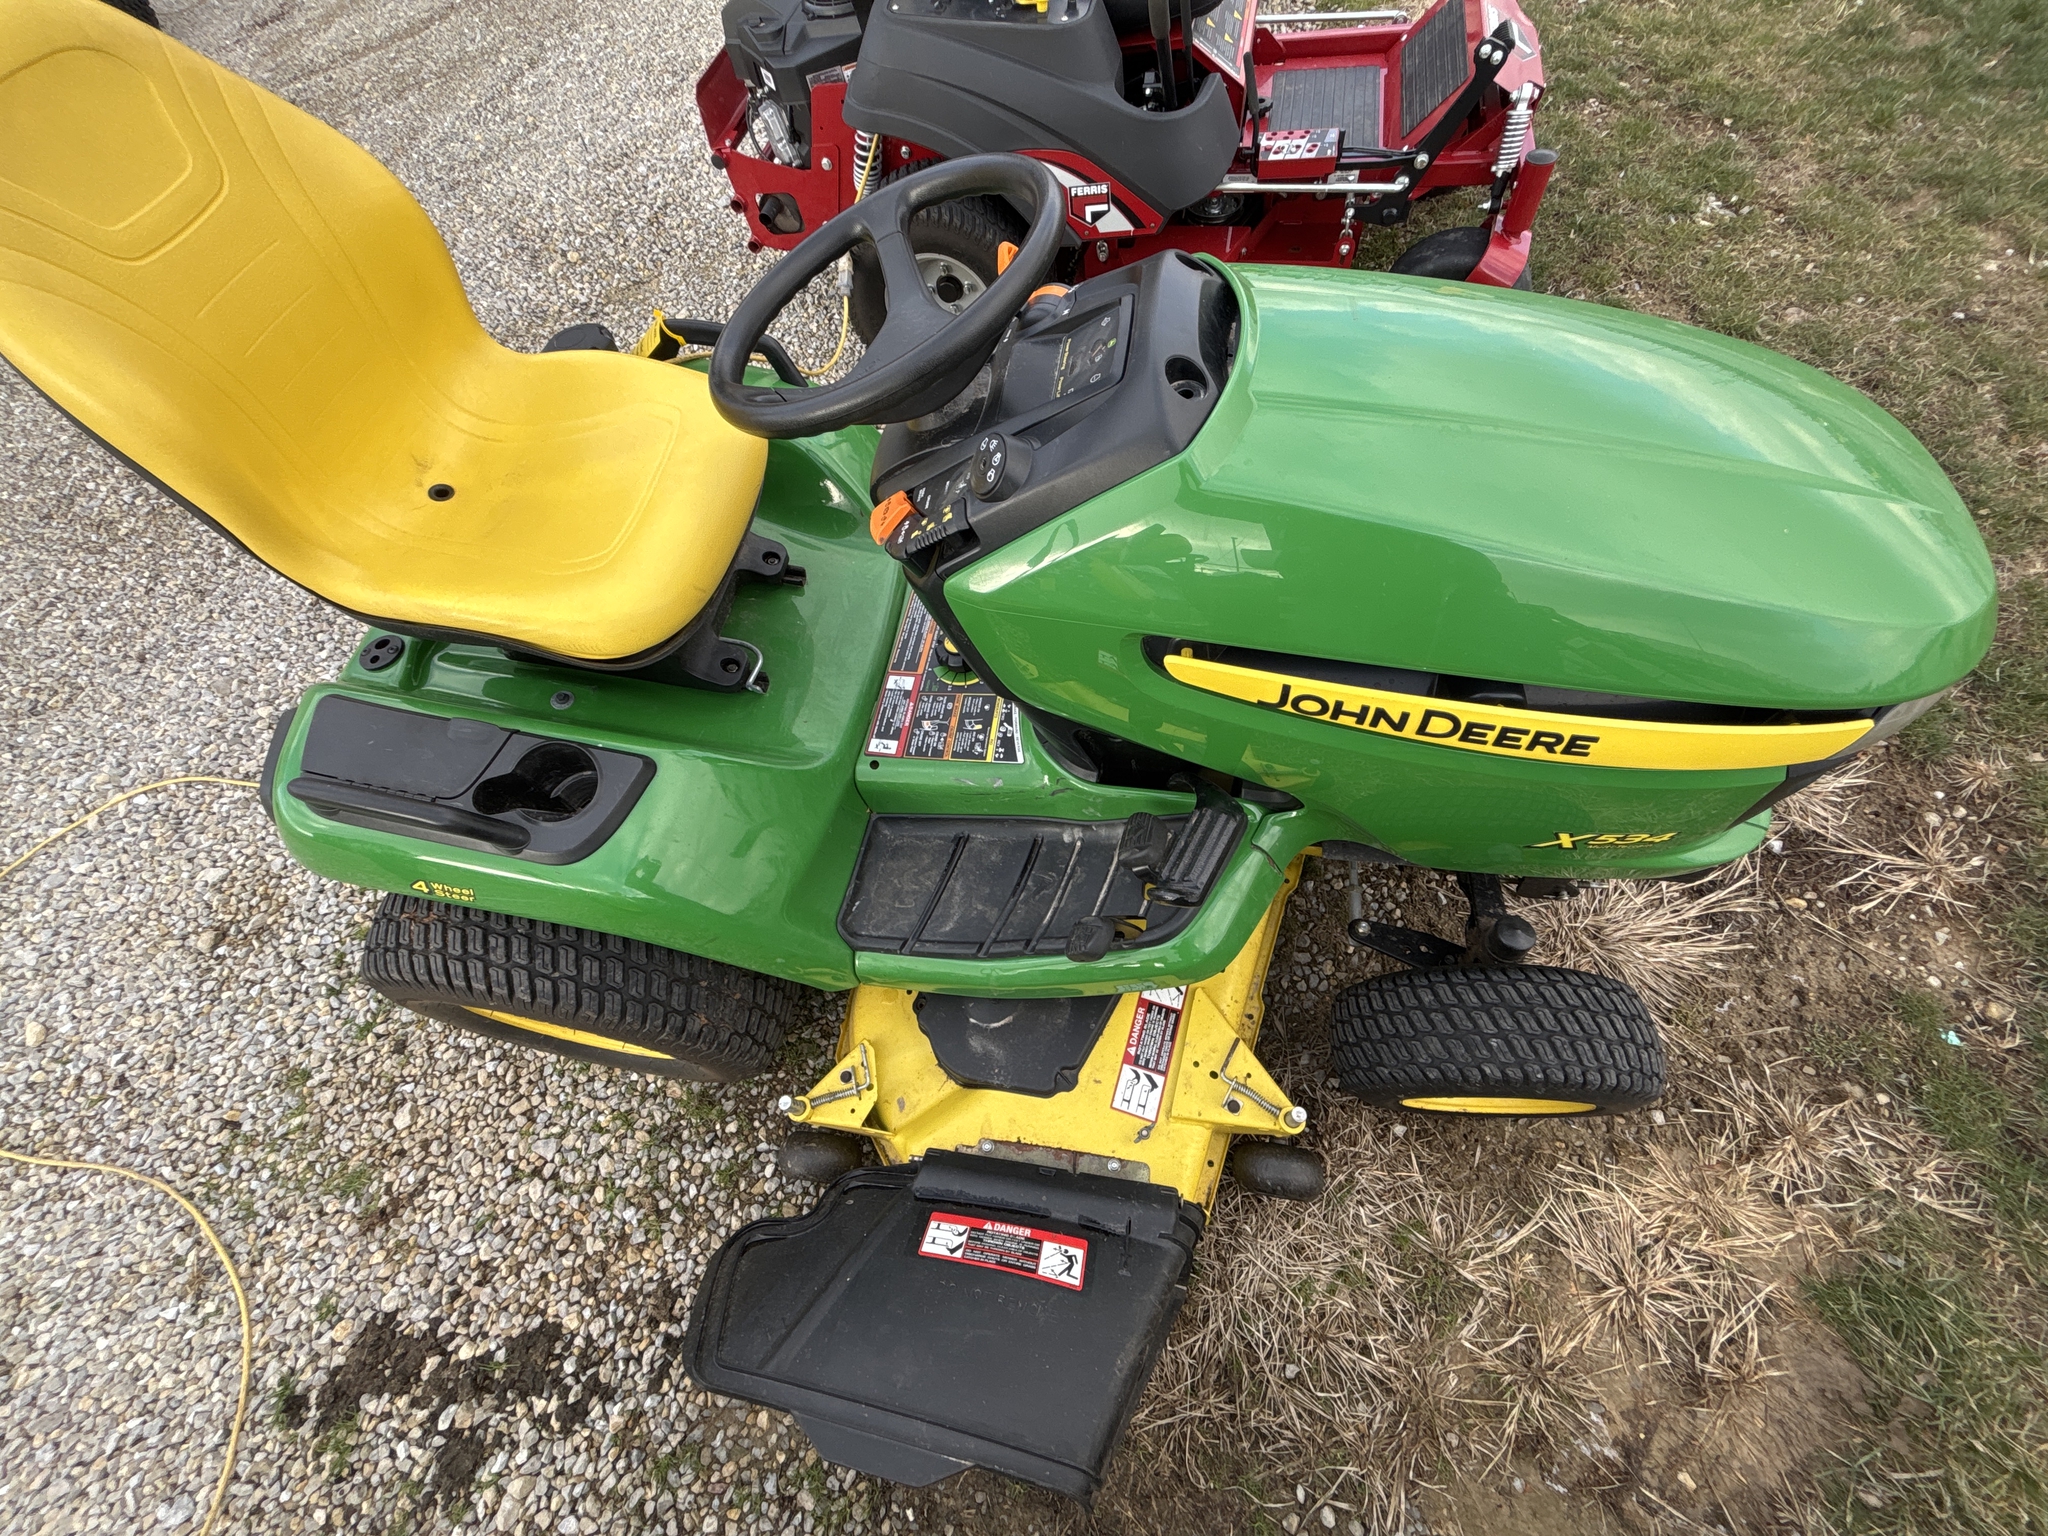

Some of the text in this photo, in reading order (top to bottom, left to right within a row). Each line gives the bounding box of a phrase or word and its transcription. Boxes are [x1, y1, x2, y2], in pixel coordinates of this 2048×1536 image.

[1071, 184, 1108, 197] FERRIS
[1257, 684, 1600, 757] JOHN DEERE
[1523, 832, 1681, 849] X534
[412, 881, 474, 895] 4 Wheel
[435, 890, 475, 902] Steer
[1130, 1008, 1145, 1045] DANGER
[994, 1223, 1031, 1236] DANGER
